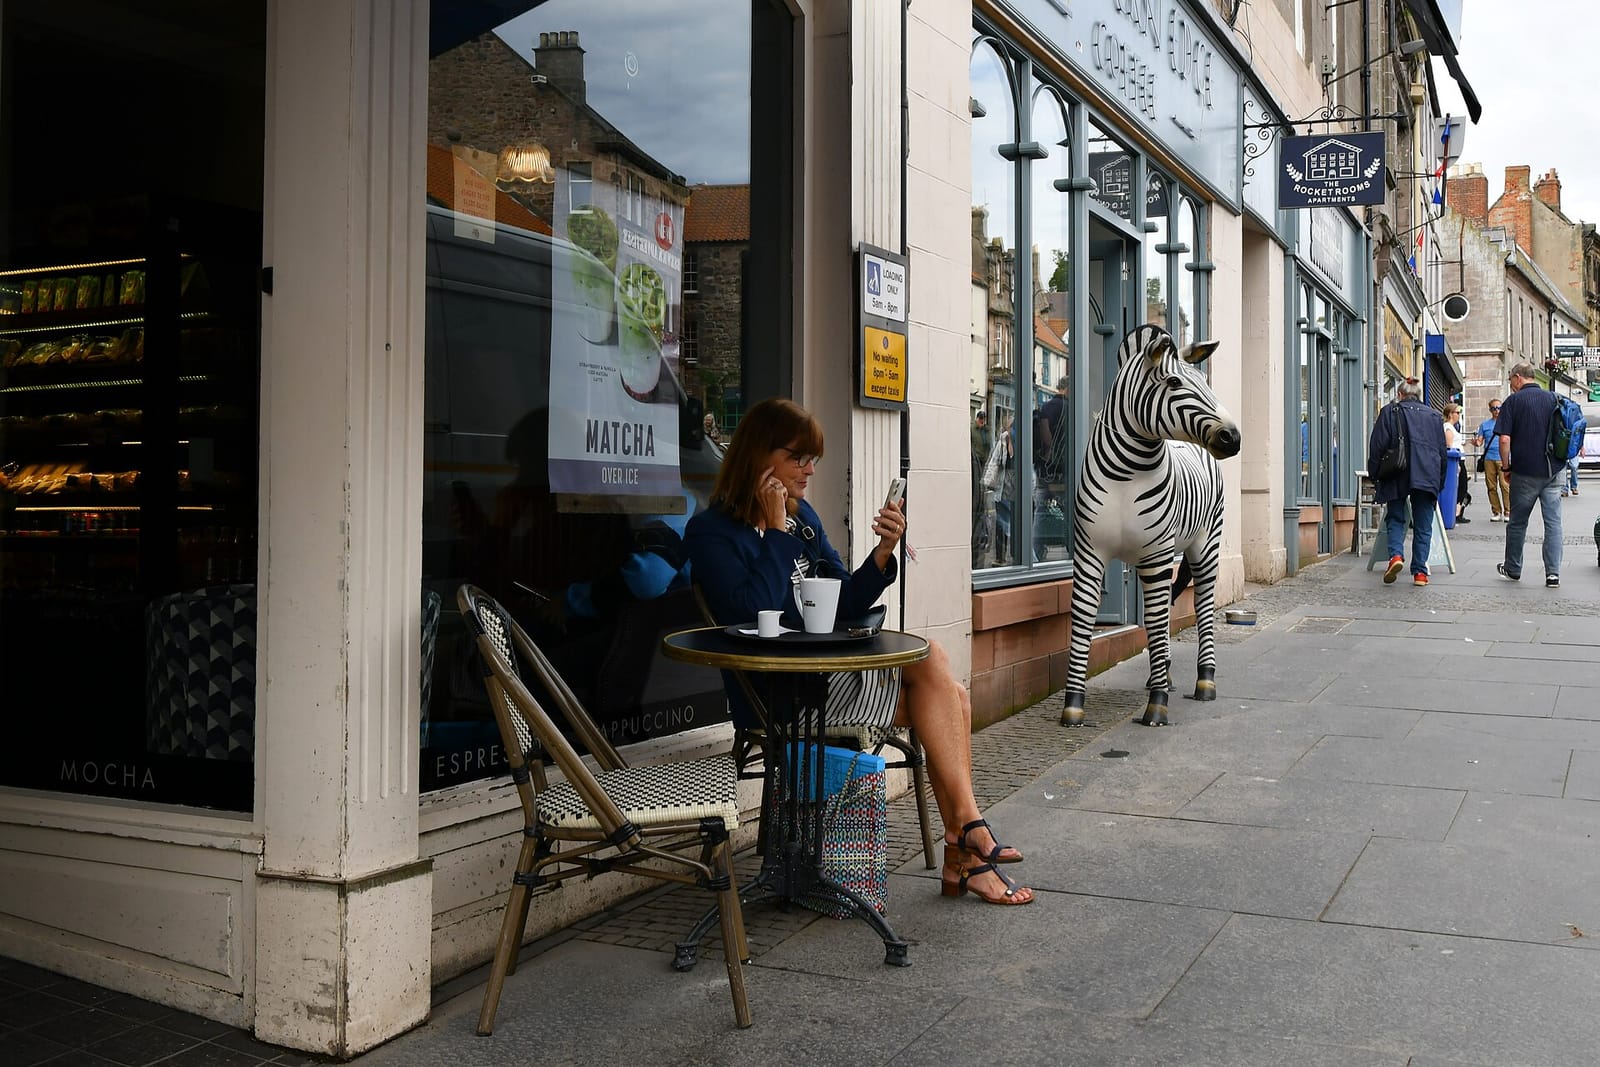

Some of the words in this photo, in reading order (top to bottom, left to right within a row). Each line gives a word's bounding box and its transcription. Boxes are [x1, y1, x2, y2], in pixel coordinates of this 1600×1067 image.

[1091, 22, 1157, 121] COFFEE
[1293, 184, 1333, 196] ROCKET
[1336, 181, 1371, 196] ROOMS
[1307, 196, 1356, 204] APARTMENTS
[882, 269, 903, 283] LOADING
[887, 284, 898, 295] ONLY
[872, 297, 884, 309] 5am
[887, 301, 899, 314] 8pm
[873, 351, 881, 362] No
[881, 354, 898, 368] waiting
[888, 370, 899, 380] 5am
[871, 384, 887, 396] except
[888, 386, 899, 396] taxis
[586, 419, 655, 457] MATCHA
[601, 466, 623, 485] OVER
[625, 468, 639, 485] ICE
[600, 704, 695, 740] APPUCCINO
[60, 759, 156, 789] MOCHA
